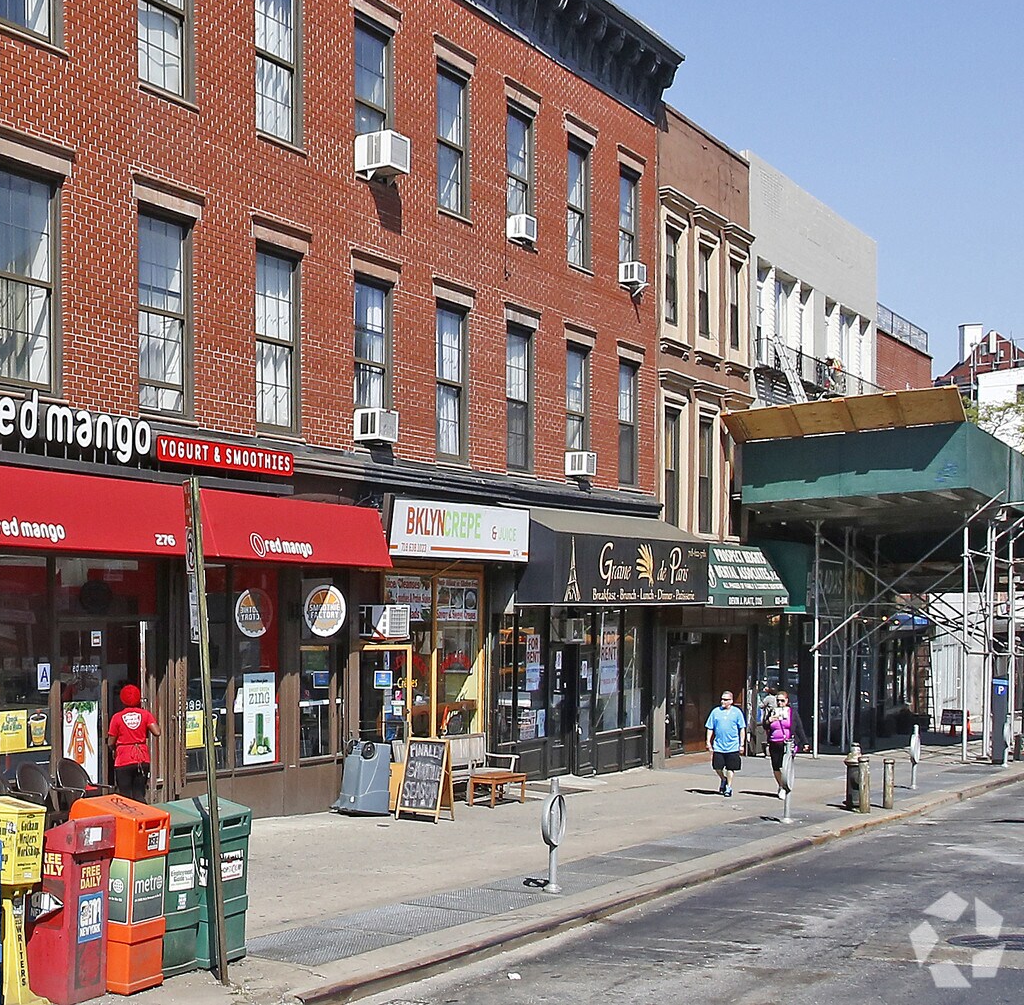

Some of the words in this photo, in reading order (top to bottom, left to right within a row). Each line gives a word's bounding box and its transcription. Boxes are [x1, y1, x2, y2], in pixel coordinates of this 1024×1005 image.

[46, 404, 151, 463] mango
[160, 439, 209, 461] YOGURT
[214, 446, 221, 463] &
[225, 448, 291, 472] SMOOTHIES
[20, 520, 67, 544] mango
[154, 533, 176, 547] 276
[491, 526, 498, 540] &
[498, 527, 517, 542] JUICE
[264, 537, 280, 553] red
[281, 541, 314, 559] mango
[713, 548, 745, 563] PROSPECT
[742, 550, 767, 564] HEIGHTS
[599, 542, 632, 585] Graine
[657, 559, 667, 582] de
[669, 546, 689, 585] Paris
[714, 564, 740, 580] DENTAL
[592, 588, 617, 602] Breakfast
[619, 588, 637, 601] Brunch
[640, 588, 654, 601] Lunch
[657, 588, 673, 601] Dinner
[310, 611, 339, 619] FACTORY
[528, 636, 539, 650] FOR
[527, 651, 540, 663] RENT
[600, 648, 617, 661] RENT
[40, 667, 49, 683] A
[410, 743, 444, 759] FINALLY
[402, 780, 439, 800] SEASON
[81, 864, 101, 878] FREE
[80, 875, 102, 890] DAILY
[135, 875, 163, 895] metro
